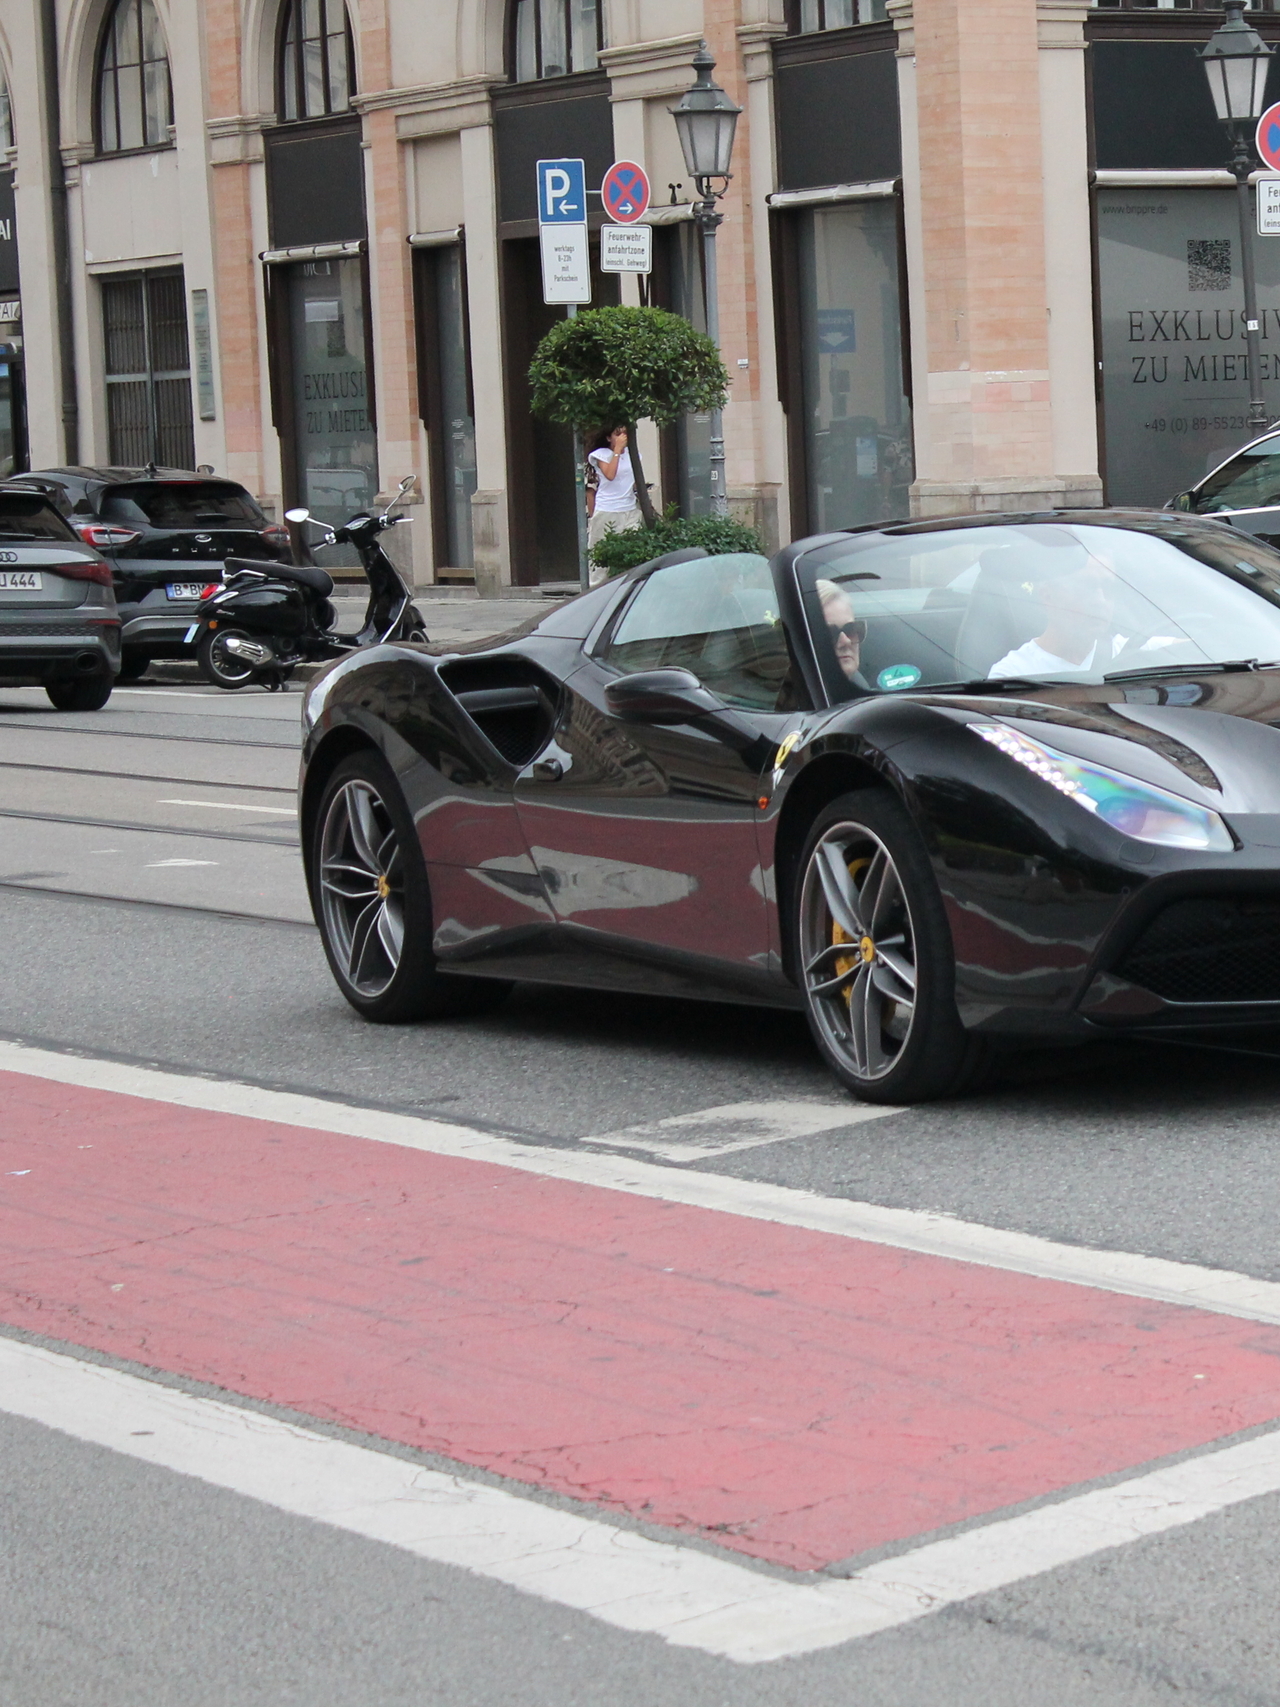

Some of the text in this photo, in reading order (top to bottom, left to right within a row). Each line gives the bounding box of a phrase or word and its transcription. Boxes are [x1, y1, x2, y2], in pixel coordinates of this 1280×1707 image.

[545, 168, 571, 216] P
[608, 231, 646, 242] Feuerwehr-
[553, 245, 575, 253] werktags
[607, 245, 645, 255] anfahrtzone
[1131, 356, 1169, 384] ZU
[304, 371, 368, 401] EXKLUSI
[307, 411, 322, 434] ZU
[1144, 418, 1166, 432] +49
[1170, 417, 1188, 435] (0)
[10, 573, 36, 588] 444
